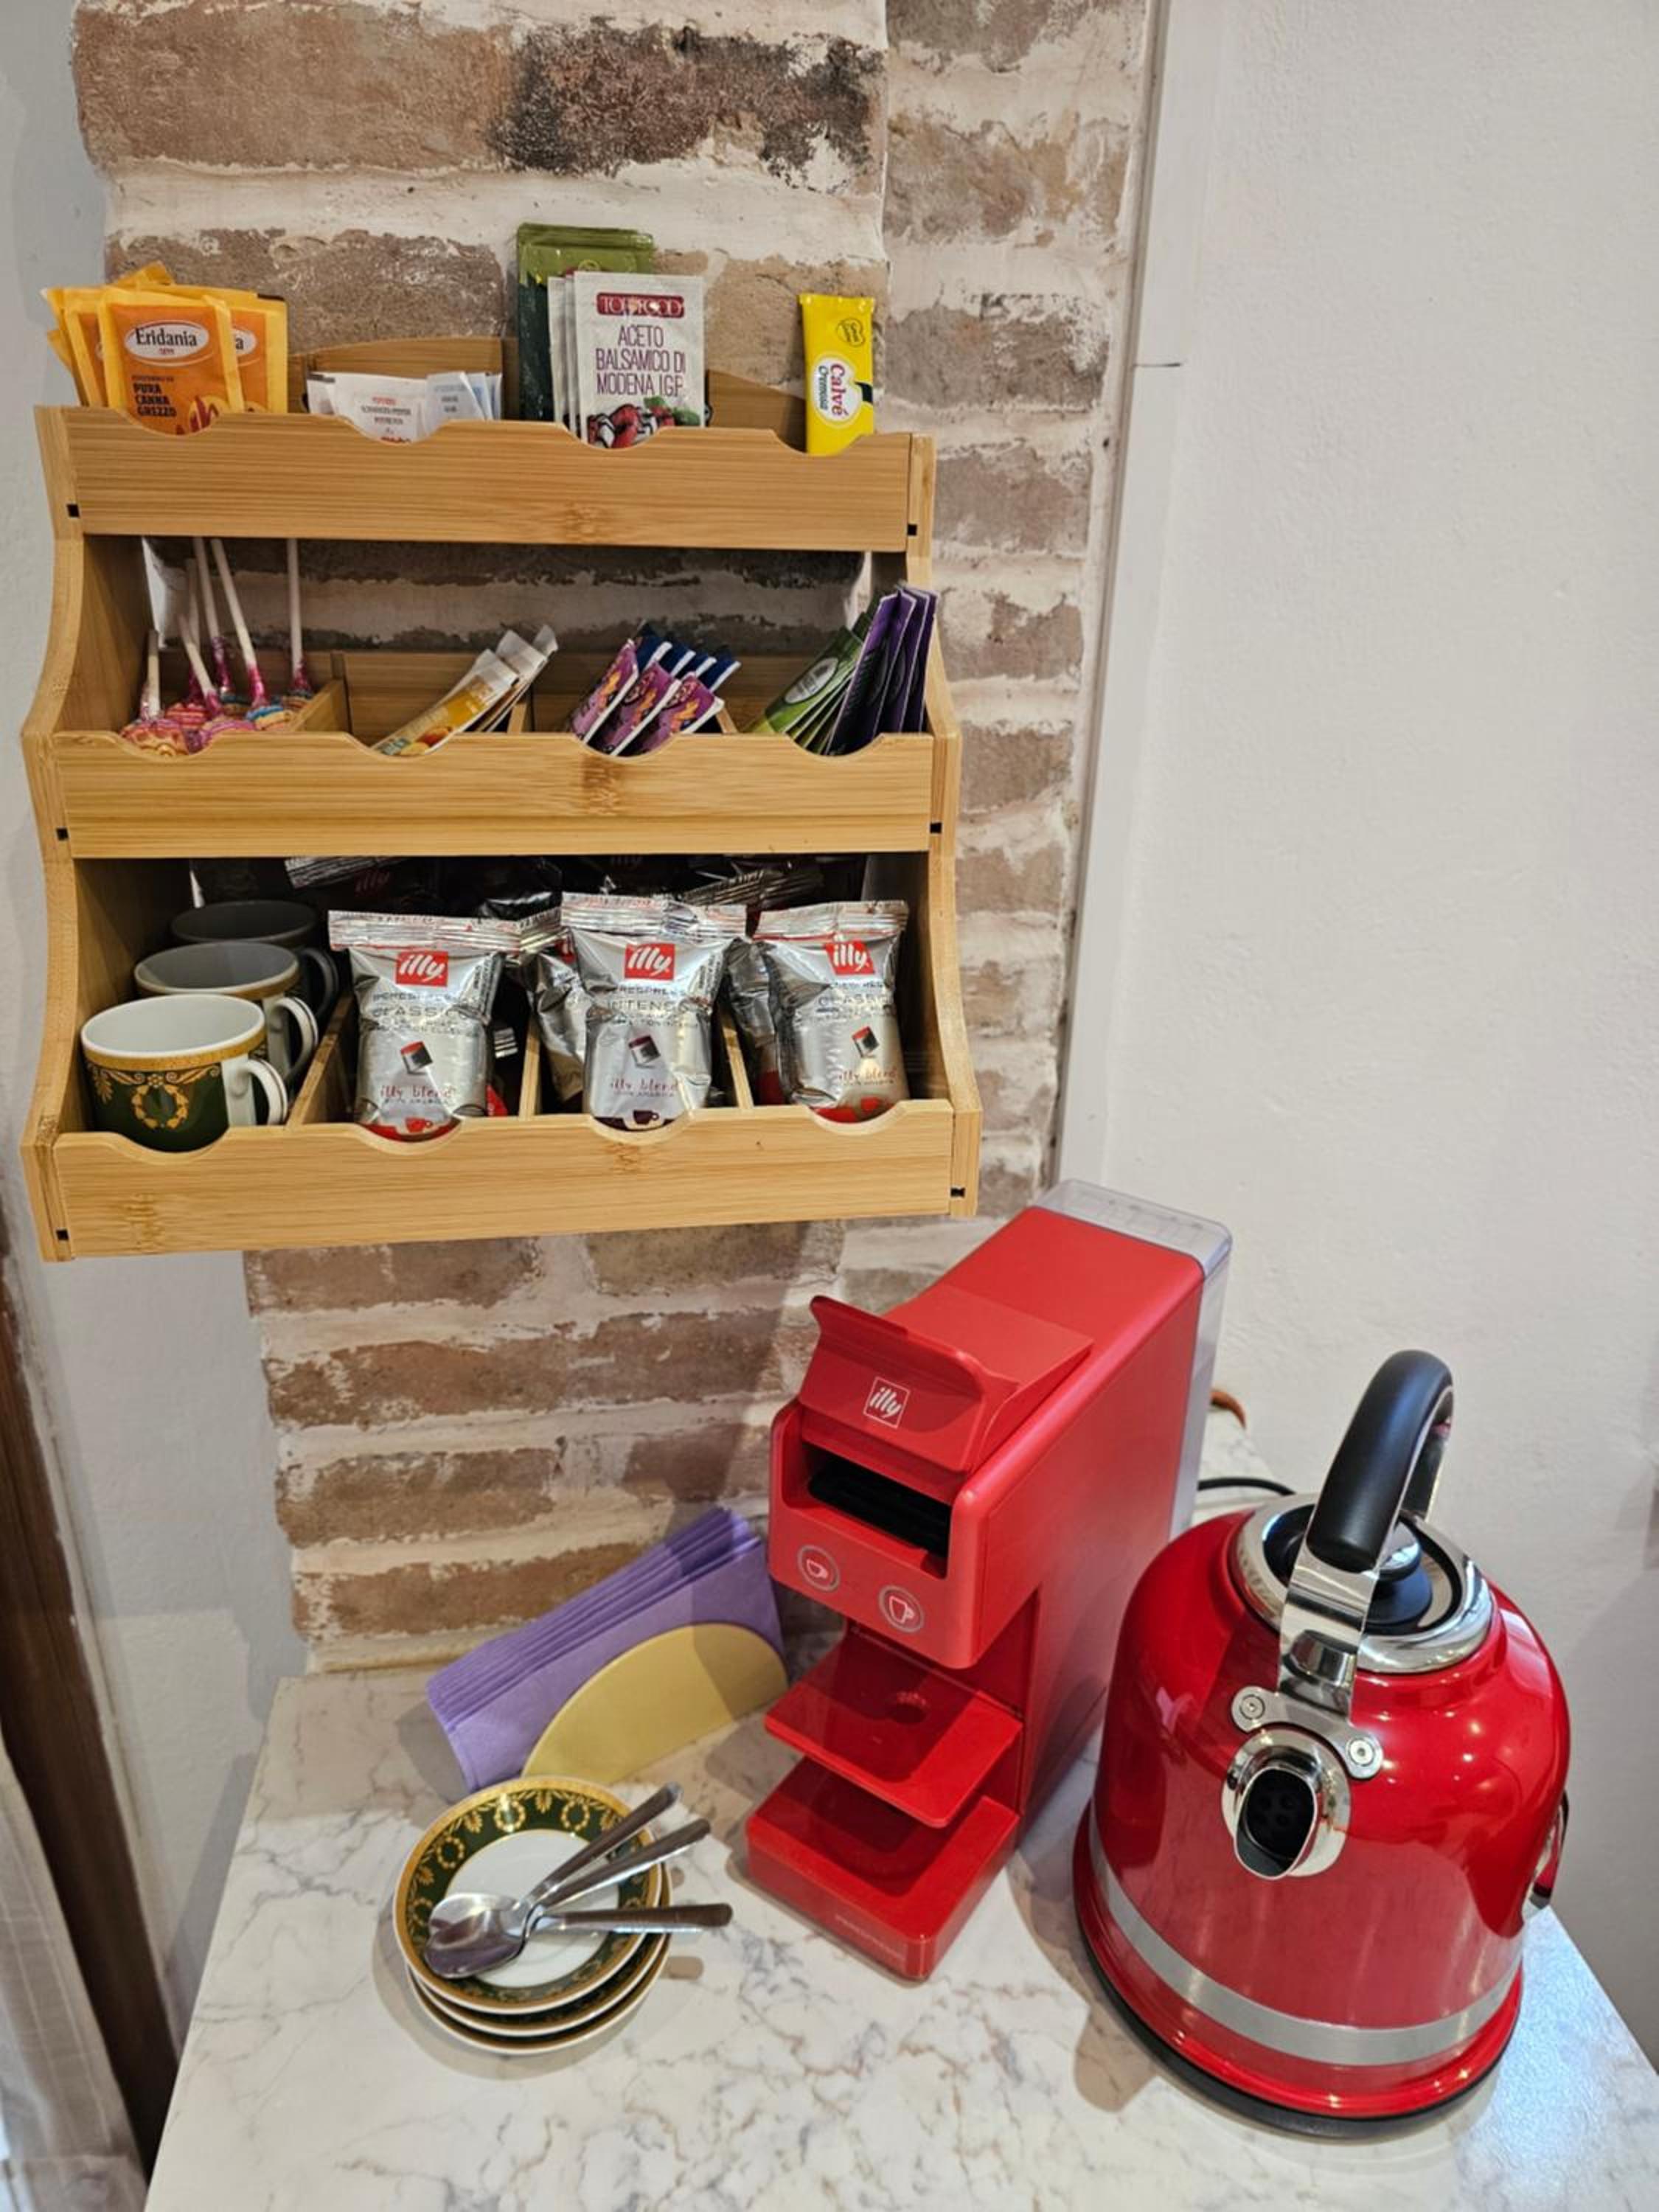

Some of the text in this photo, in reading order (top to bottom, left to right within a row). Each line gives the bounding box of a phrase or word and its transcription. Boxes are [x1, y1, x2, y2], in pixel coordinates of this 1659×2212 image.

[135, 327, 198, 347] Eridania
[618, 324, 664, 347] ACETO
[595, 347, 686, 374] BALSAMICO DI
[597, 372, 655, 395] MODENA
[830, 364, 849, 416] Calvé
[399, 954, 447, 983] illy
[627, 946, 672, 977] illy
[833, 944, 867, 973] illy
[869, 1387, 902, 1419] illy
